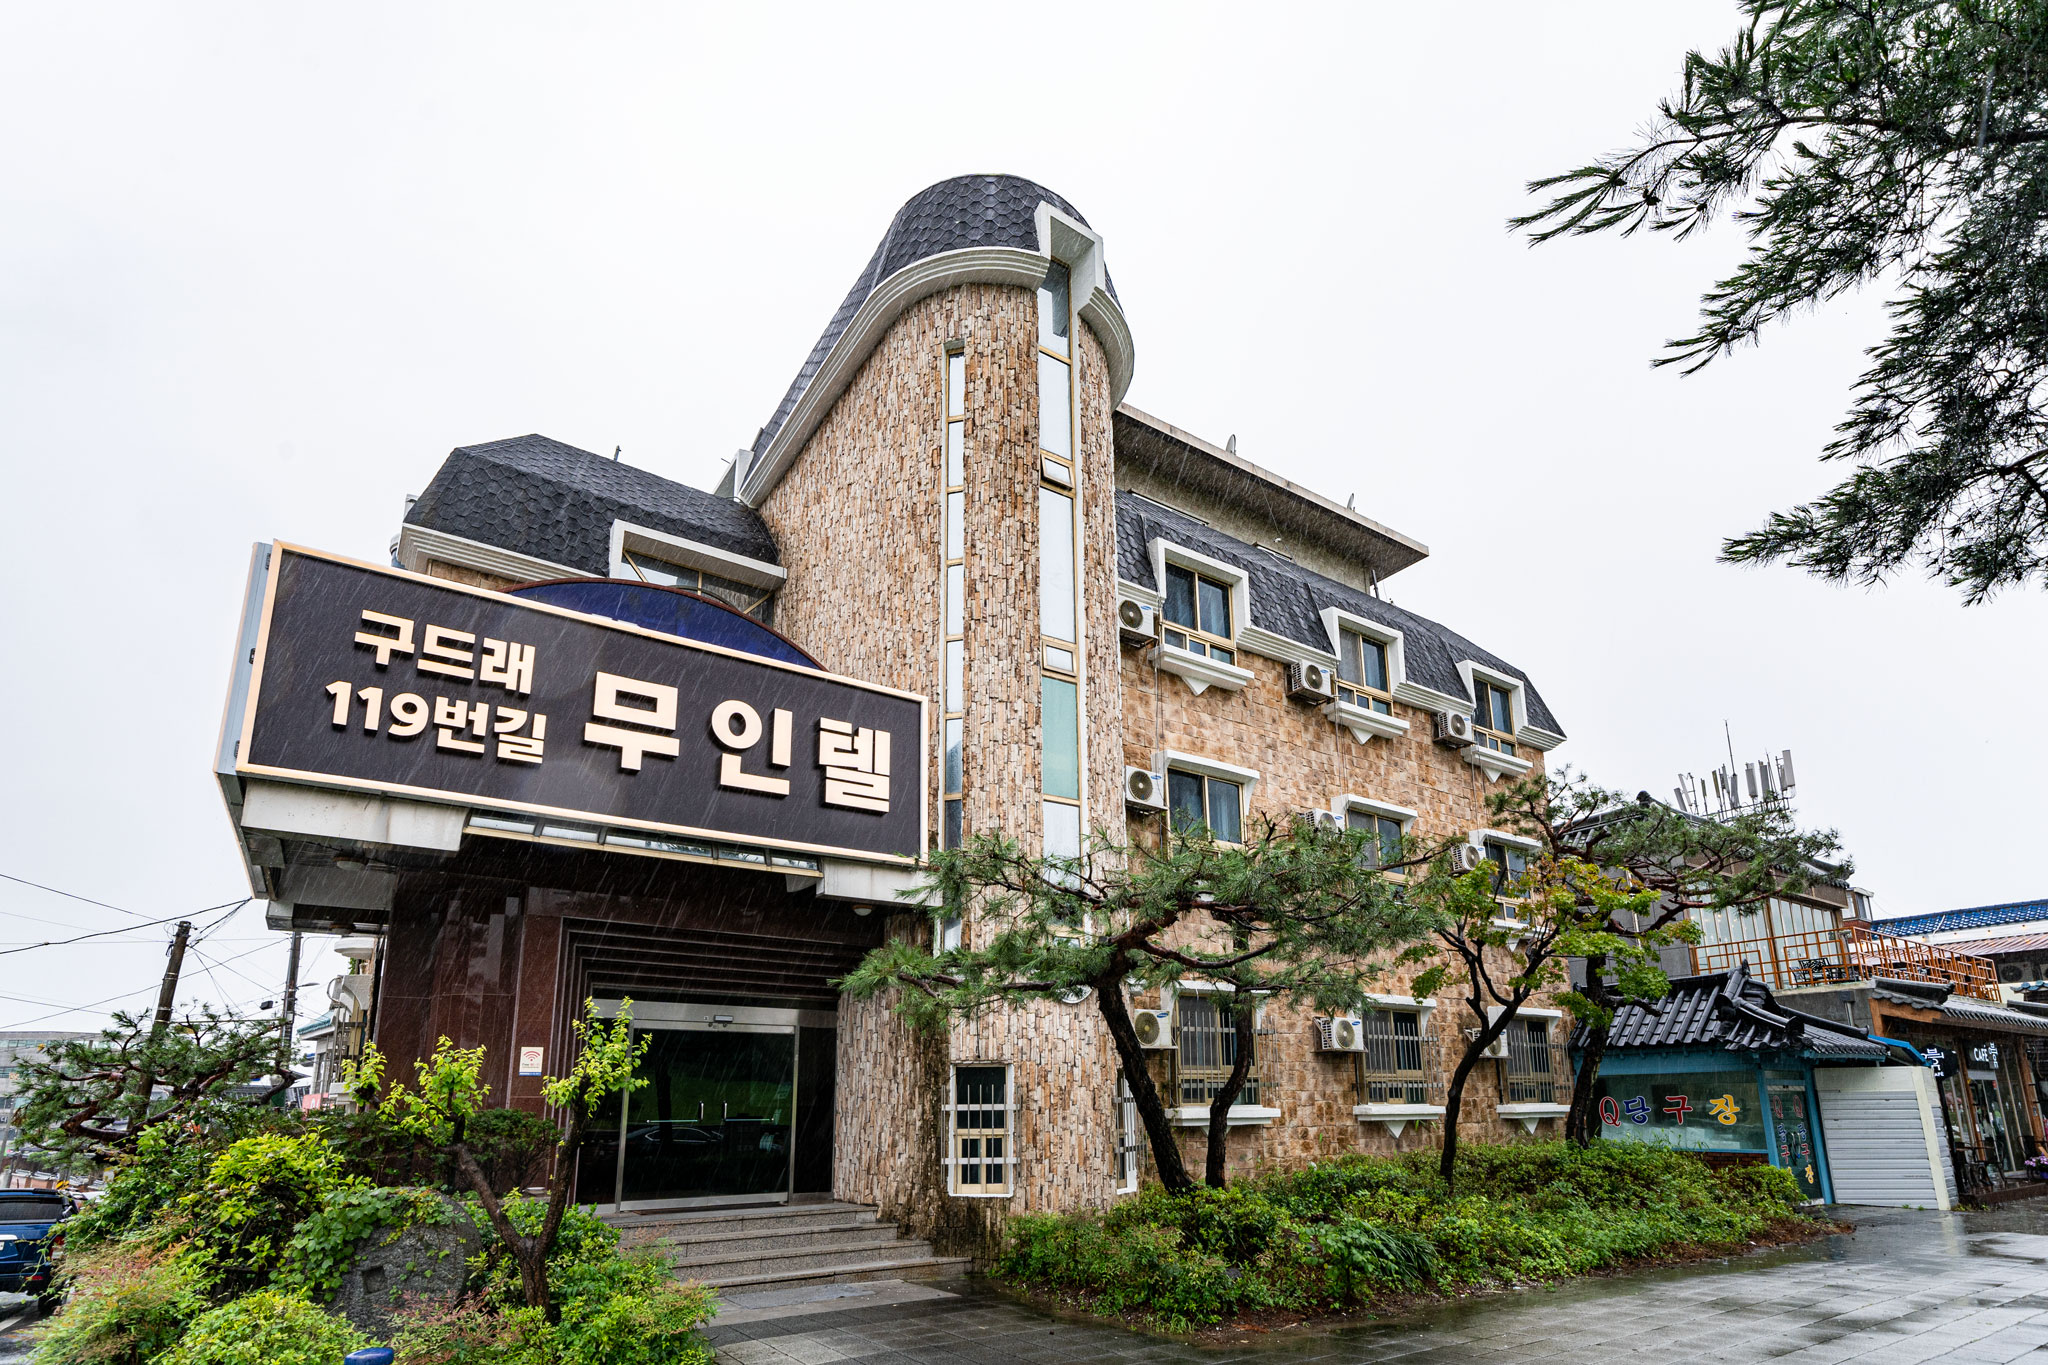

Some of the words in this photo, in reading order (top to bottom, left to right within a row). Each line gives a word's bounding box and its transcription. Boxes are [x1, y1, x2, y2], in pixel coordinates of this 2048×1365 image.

[354, 609, 536, 695] 구드래
[325, 680, 547, 764] 119번길
[584, 671, 891, 813] 무인텔
[1599, 1094, 1741, 1127] Q당구장
[1773, 1095, 1793, 1175] Q당구
